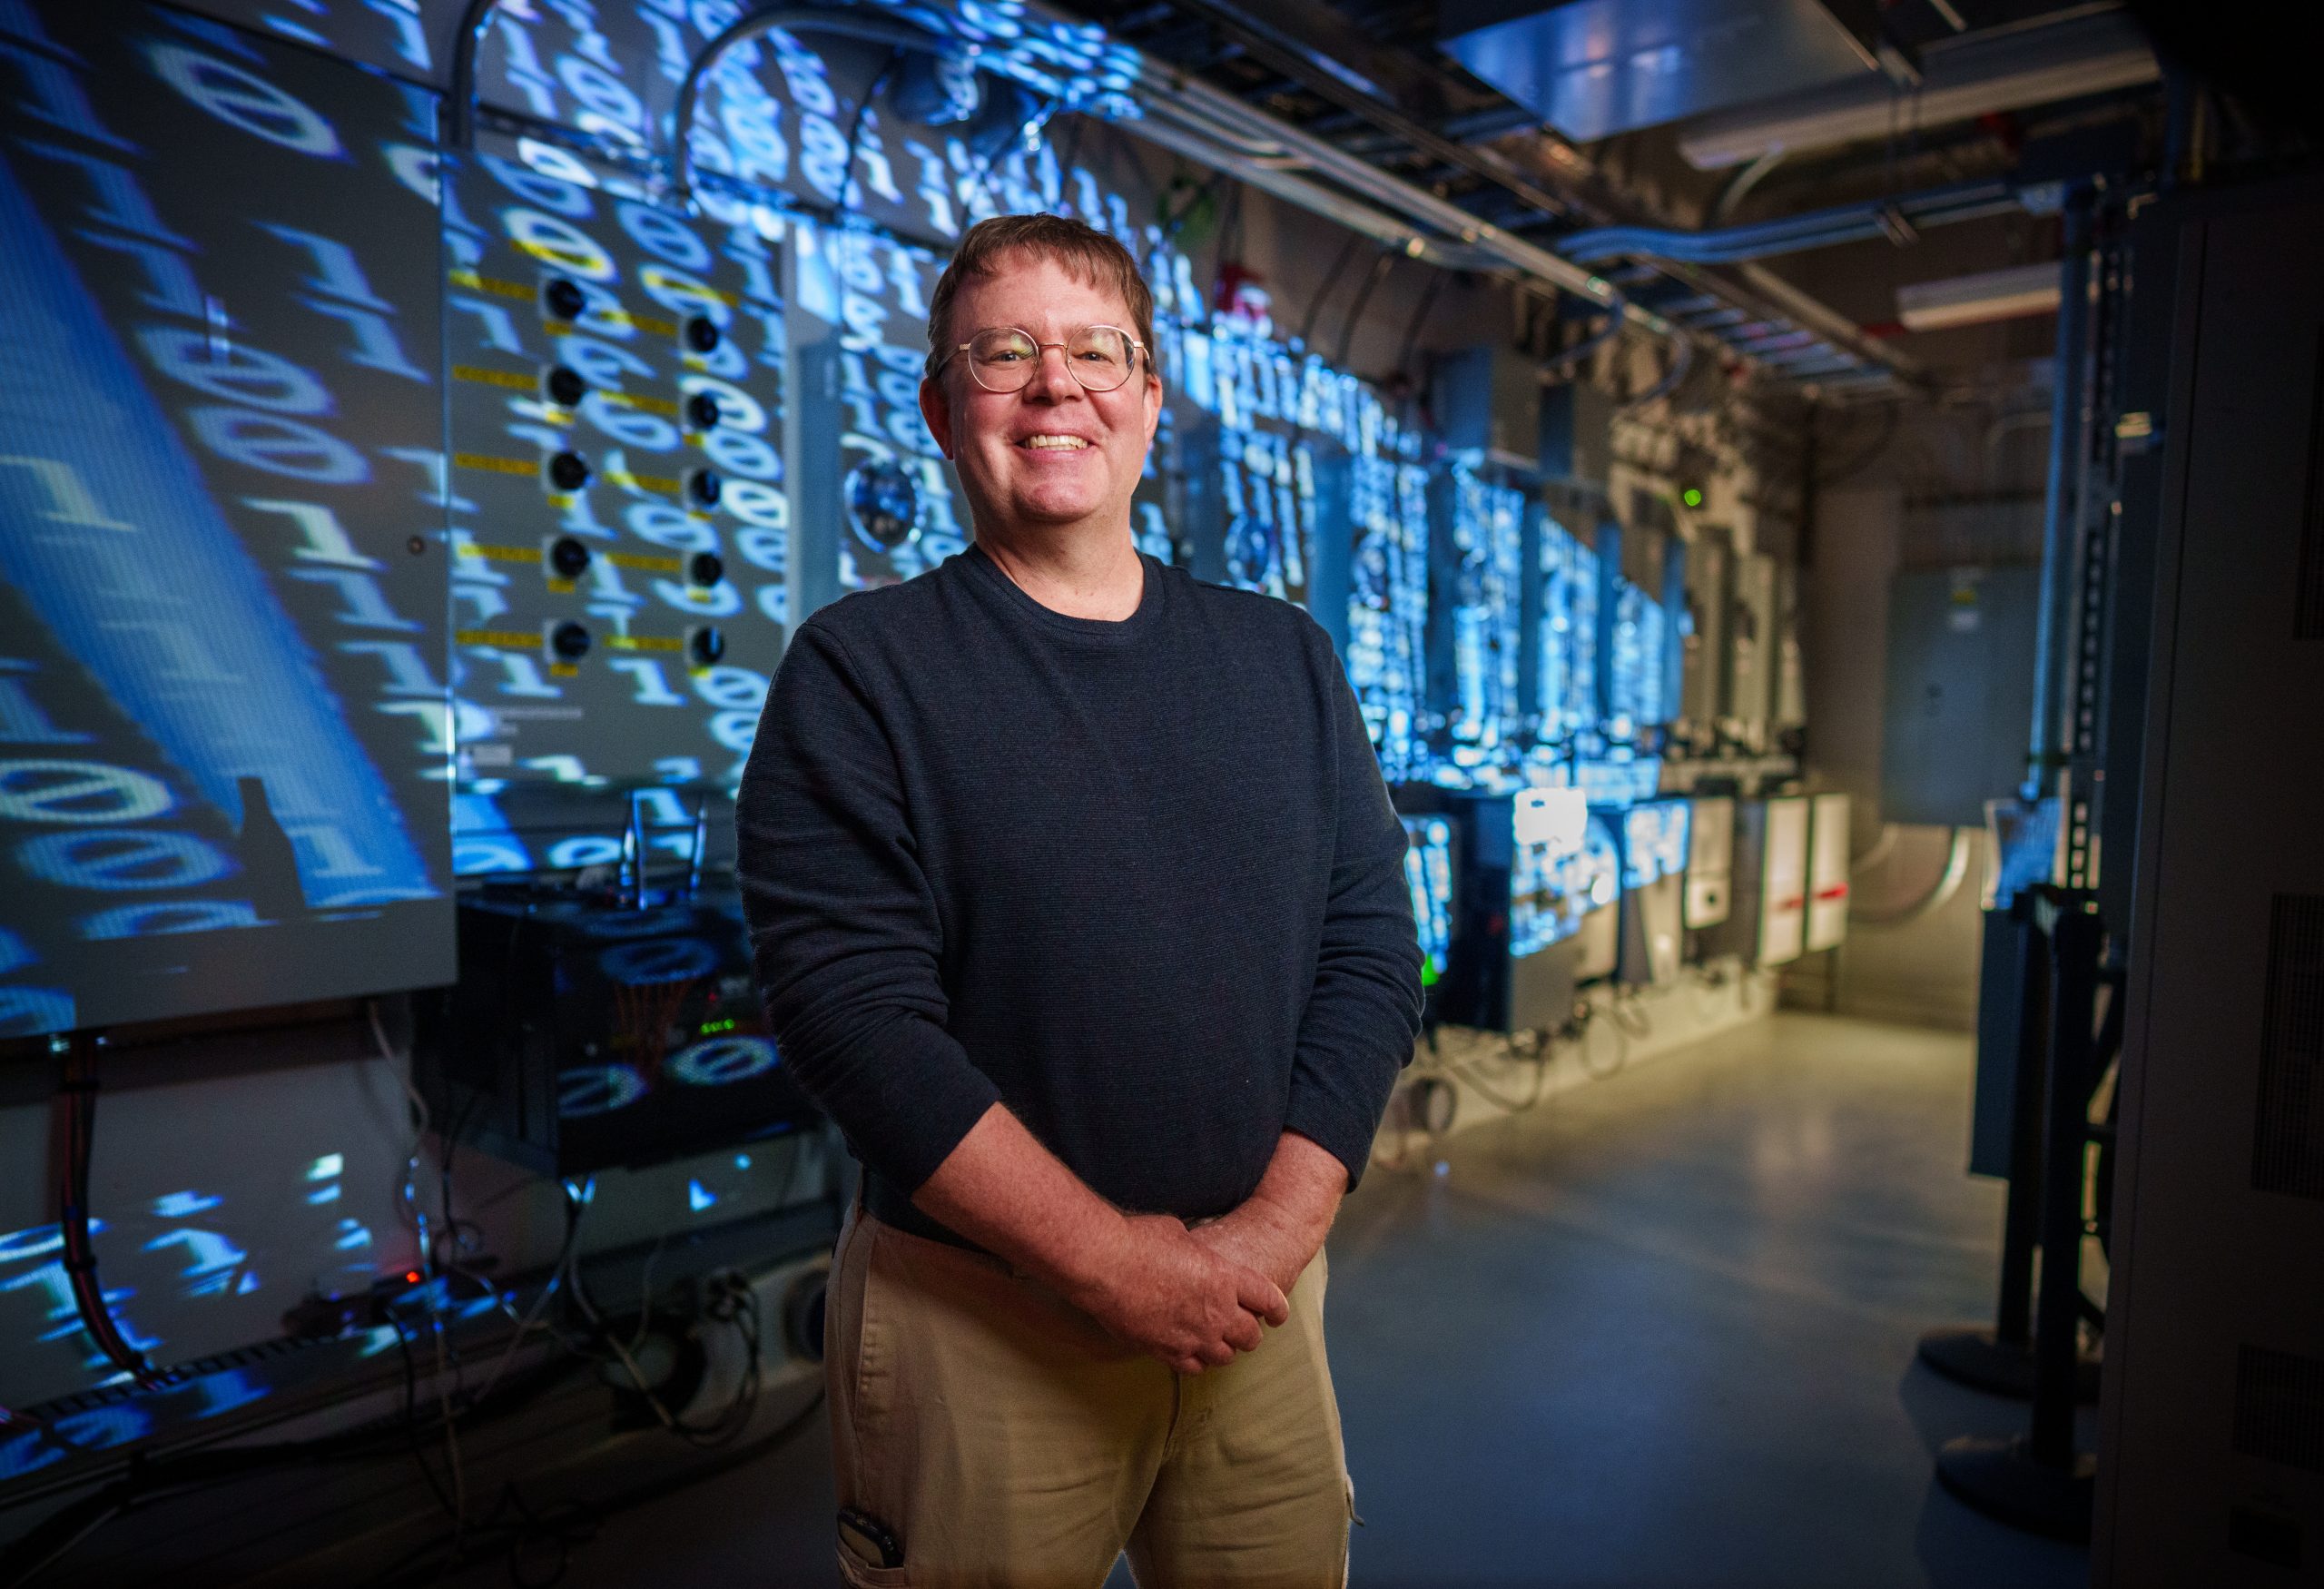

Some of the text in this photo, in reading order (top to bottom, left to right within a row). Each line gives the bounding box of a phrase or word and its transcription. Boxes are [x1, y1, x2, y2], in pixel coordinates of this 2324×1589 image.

[143, 42, 349, 161] 0
[555, 52, 644, 131] 0
[18, 138, 200, 253] 1
[254, 221, 396, 312] 1
[501, 209, 617, 283] 0
[616, 199, 712, 272] 0
[297, 294, 430, 384] 1
[449, 296, 537, 357] 1
[136, 324, 337, 418] 0
[189, 405, 370, 483] 0
[0, 455, 138, 532] 1
[623, 500, 723, 551] 0
[241, 496, 386, 570] 1
[288, 568, 425, 632] 1
[338, 638, 449, 696] 1
[464, 643, 565, 698] 1
[606, 656, 687, 706] 1
[0, 759, 182, 823] 0
[16, 827, 241, 893] 0
[284, 823, 383, 881] 1
[601, 938, 720, 986] 0
[664, 1036, 779, 1085] 0
